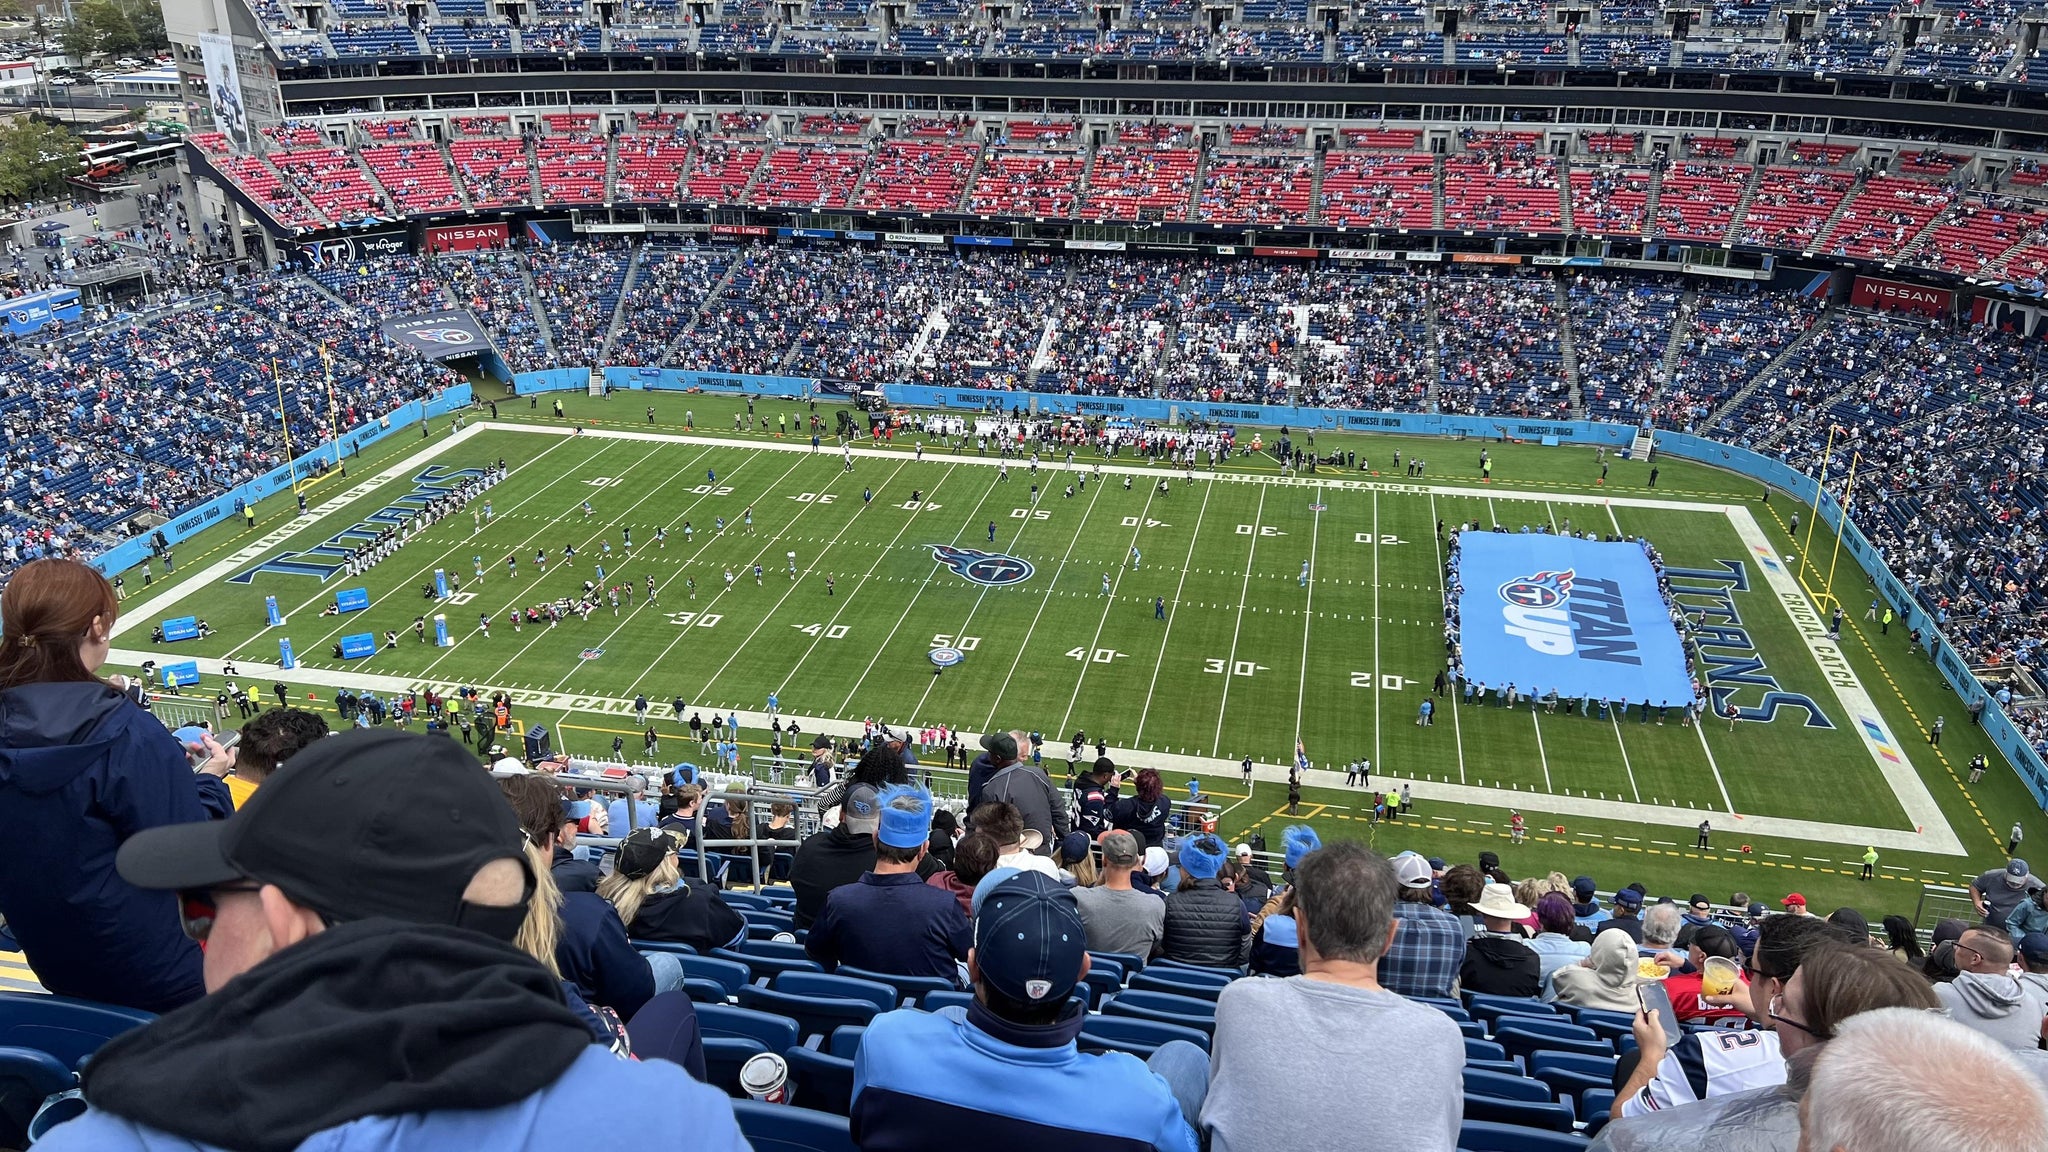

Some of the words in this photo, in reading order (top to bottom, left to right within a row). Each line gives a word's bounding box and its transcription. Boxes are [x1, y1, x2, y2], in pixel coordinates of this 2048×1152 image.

[437, 228, 498, 241] NISSAN
[376, 238, 404, 253] Kroger
[1534, 256, 1561, 264] Pinnacle
[1866, 283, 1938, 304] NISSAN
[394, 316, 458, 330] NISSAN
[446, 350, 478, 360] NISSAN
[698, 376, 725, 386] TENNESSEE
[726, 379, 743, 388] TOUGH
[957, 394, 984, 404] TENNESSEE
[1076, 401, 1104, 410] TENNESSEE
[1106, 403, 1124, 412] TOUGH
[1209, 409, 1239, 418] TENNESSEE
[1241, 410, 1260, 419] TOUGH
[1348, 416, 1380, 426] TENNESSEE
[1382, 418, 1401, 427] TOUGH
[1518, 425, 1551, 434] TENNESSEE
[1553, 428, 1573, 436] TOUGH
[272, 470, 296, 486] TENNESSE
[296, 460, 312, 474] TOUGH
[1214, 473, 1334, 486] INTERCEPT
[1342, 481, 1432, 492] CANCER
[176, 514, 203, 536] TENNESSEE
[204, 506, 220, 522] TOUGH
[227, 555, 252, 563] IT
[251, 519, 312, 549] TAKES
[314, 496, 346, 516] ALL
[347, 487, 367, 498] OF
[370, 475, 391, 486] US
[1568, 577, 1643, 666] TITAN
[1502, 604, 1575, 656] UP
[1780, 592, 1816, 640] CRUCIAL
[1814, 645, 1857, 688] CATCH
[1208, 822, 1214, 830] G
[1714, 1031, 1763, 1053] 2
